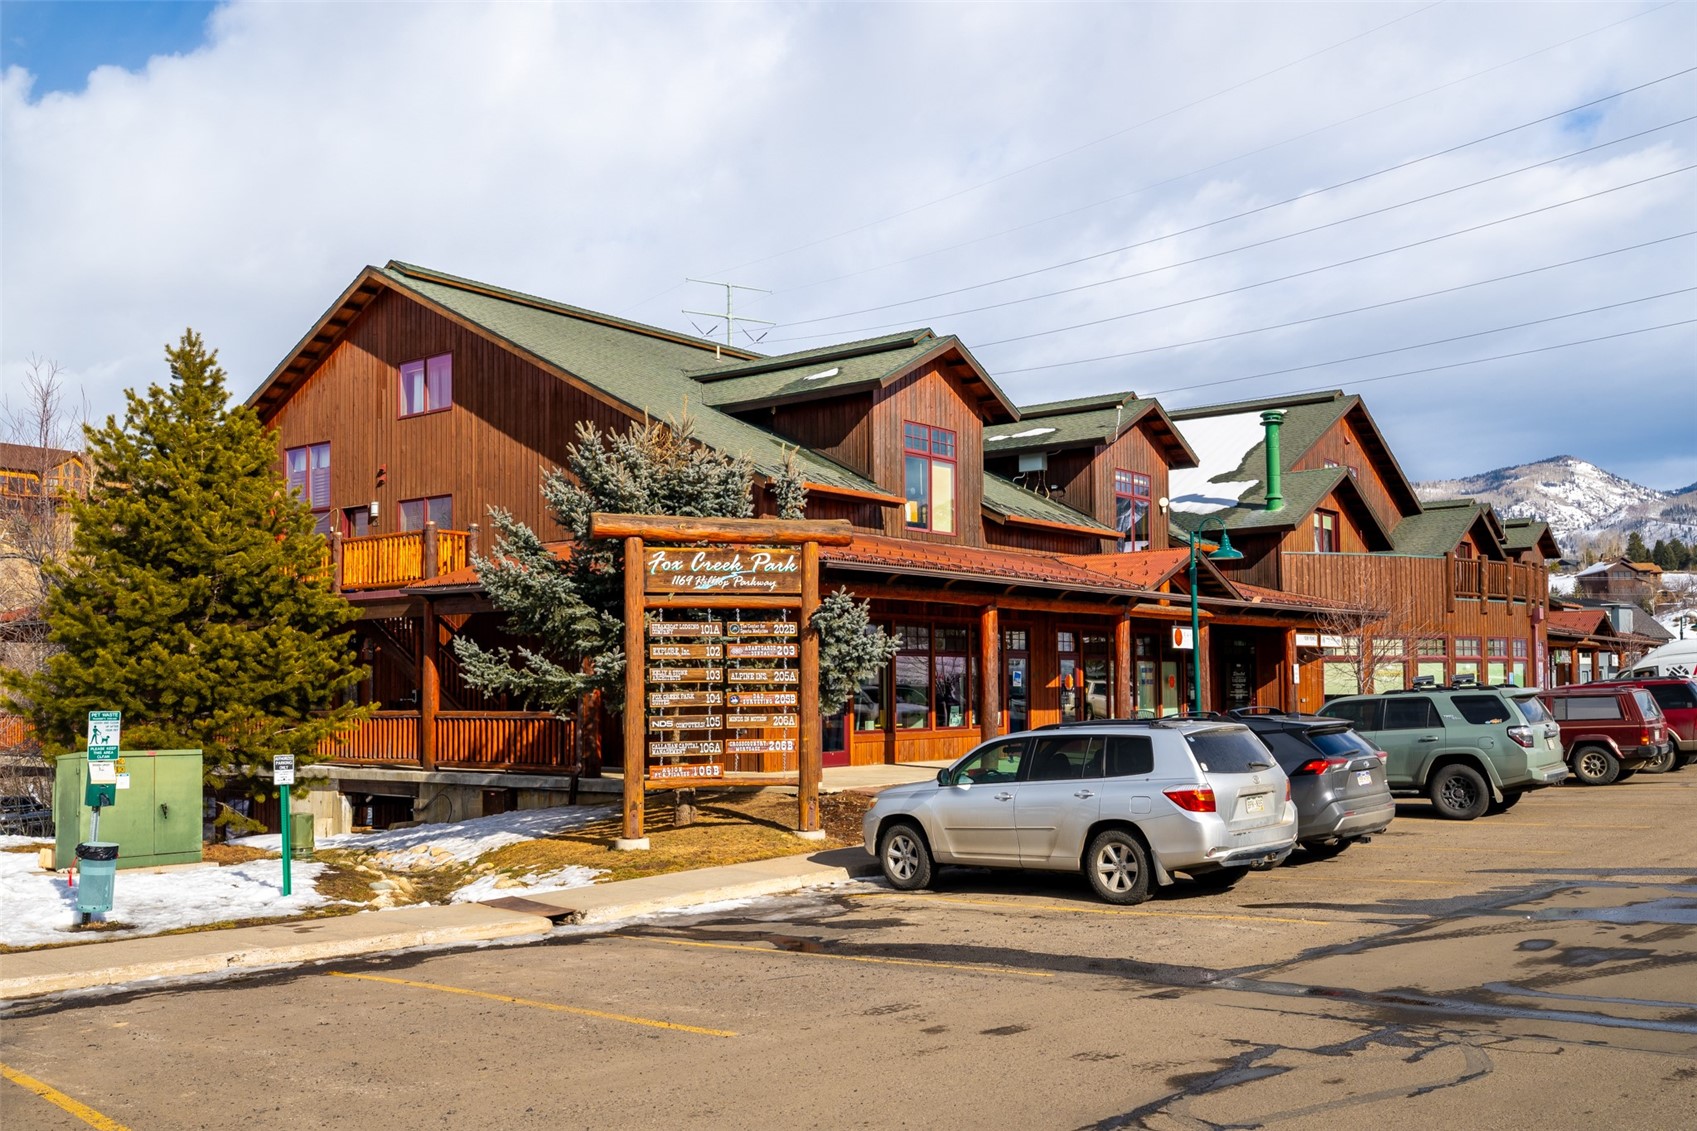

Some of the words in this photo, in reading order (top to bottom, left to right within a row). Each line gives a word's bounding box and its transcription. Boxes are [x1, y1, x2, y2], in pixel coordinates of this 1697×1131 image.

[648, 551, 683, 575] Fox
[691, 552, 743, 572] Creek
[751, 552, 798, 572] Park
[671, 575, 691, 585] 1169
[733, 576, 777, 591] Parkway
[701, 625, 720, 634] 101A
[774, 625, 795, 634] 202B
[653, 647, 680, 657] EXPLORE,
[681, 647, 691, 656] Inc.
[706, 647, 720, 657] 102
[777, 646, 795, 656] 203
[706, 670, 720, 680] 103
[731, 672, 754, 680] ALPINE
[774, 671, 796, 681] 205A
[706, 693, 721, 703] 104
[775, 694, 796, 704] 205B
[706, 716, 720, 727] 105
[773, 716, 795, 726] 206A
[700, 743, 721, 753] 106A
[769, 741, 793, 751] 206B
[693, 765, 720, 776] 106B
